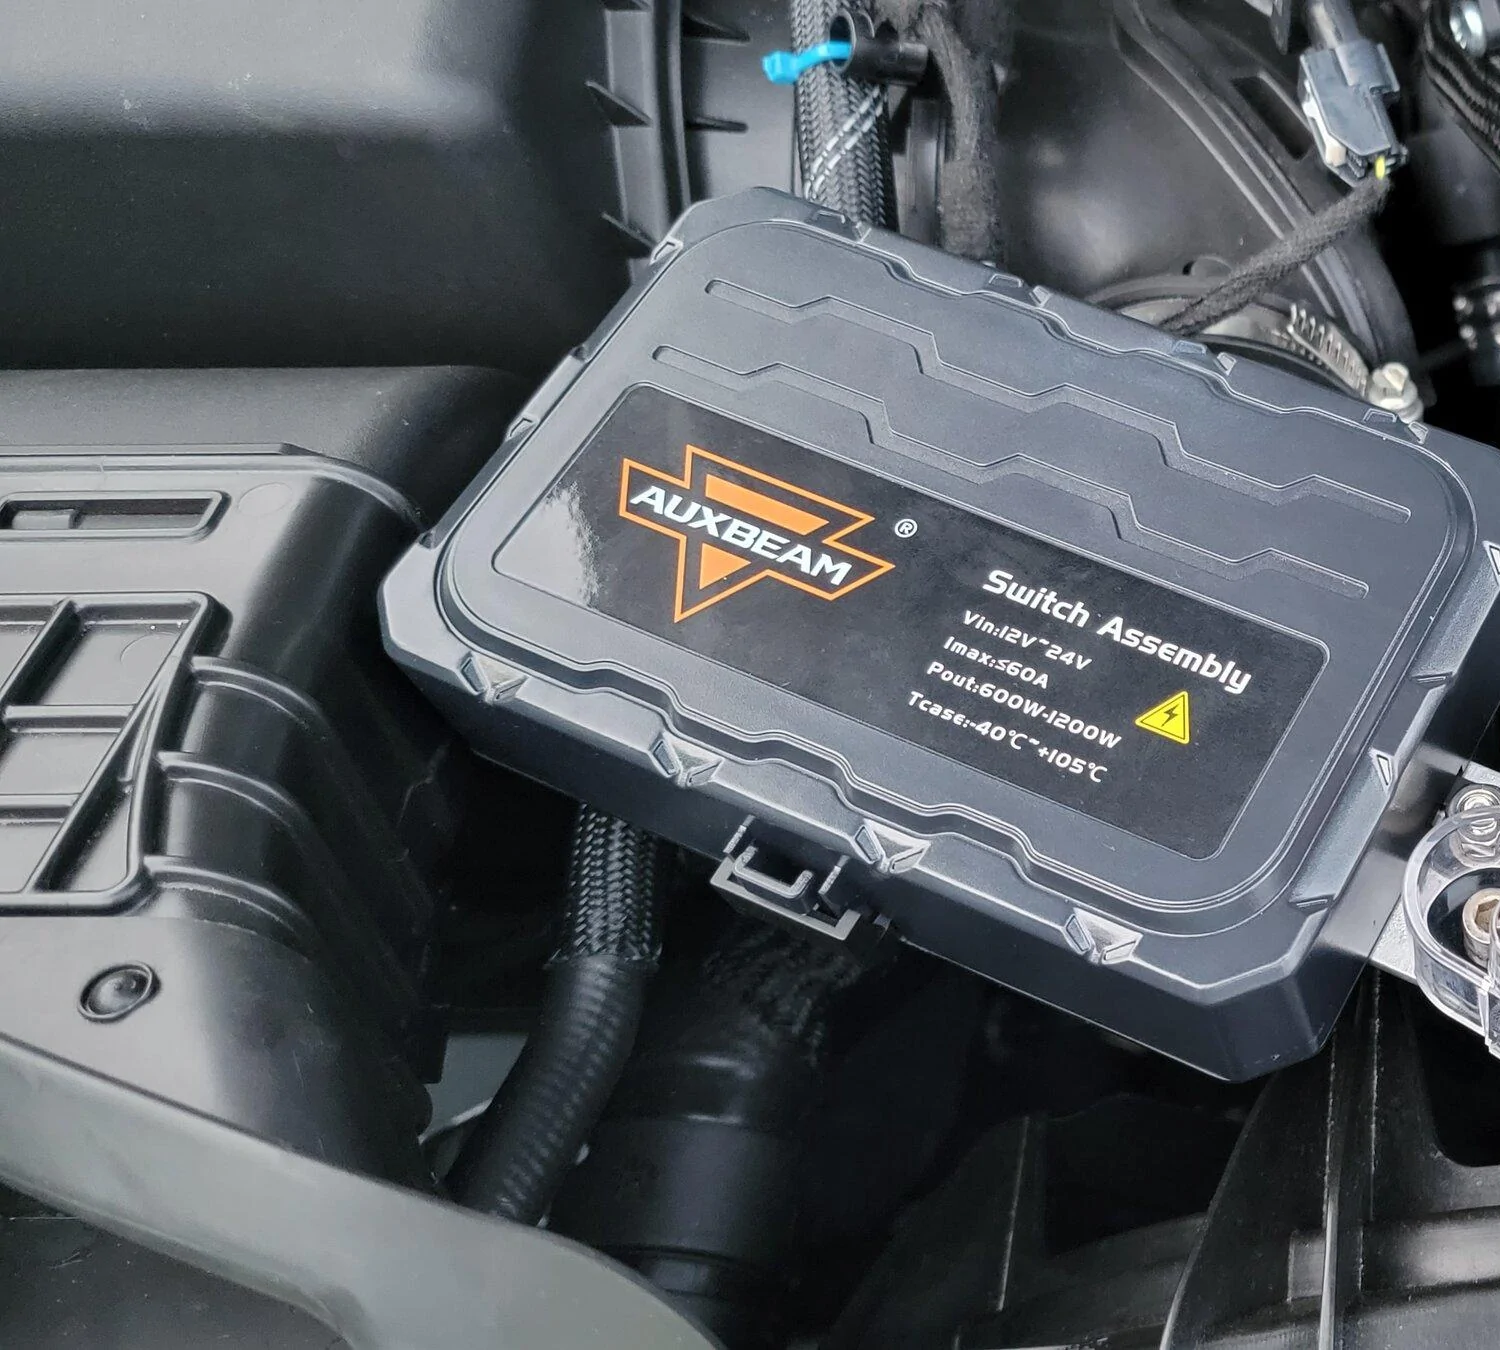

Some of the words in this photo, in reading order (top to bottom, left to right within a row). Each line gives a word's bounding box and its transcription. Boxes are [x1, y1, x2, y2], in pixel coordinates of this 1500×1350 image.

[629, 485, 852, 586] AUXBEAM
[982, 569, 1090, 628] Switch
[1096, 616, 1252, 695] Assembly
[926, 661, 1123, 749] Pout:600W-1200W
